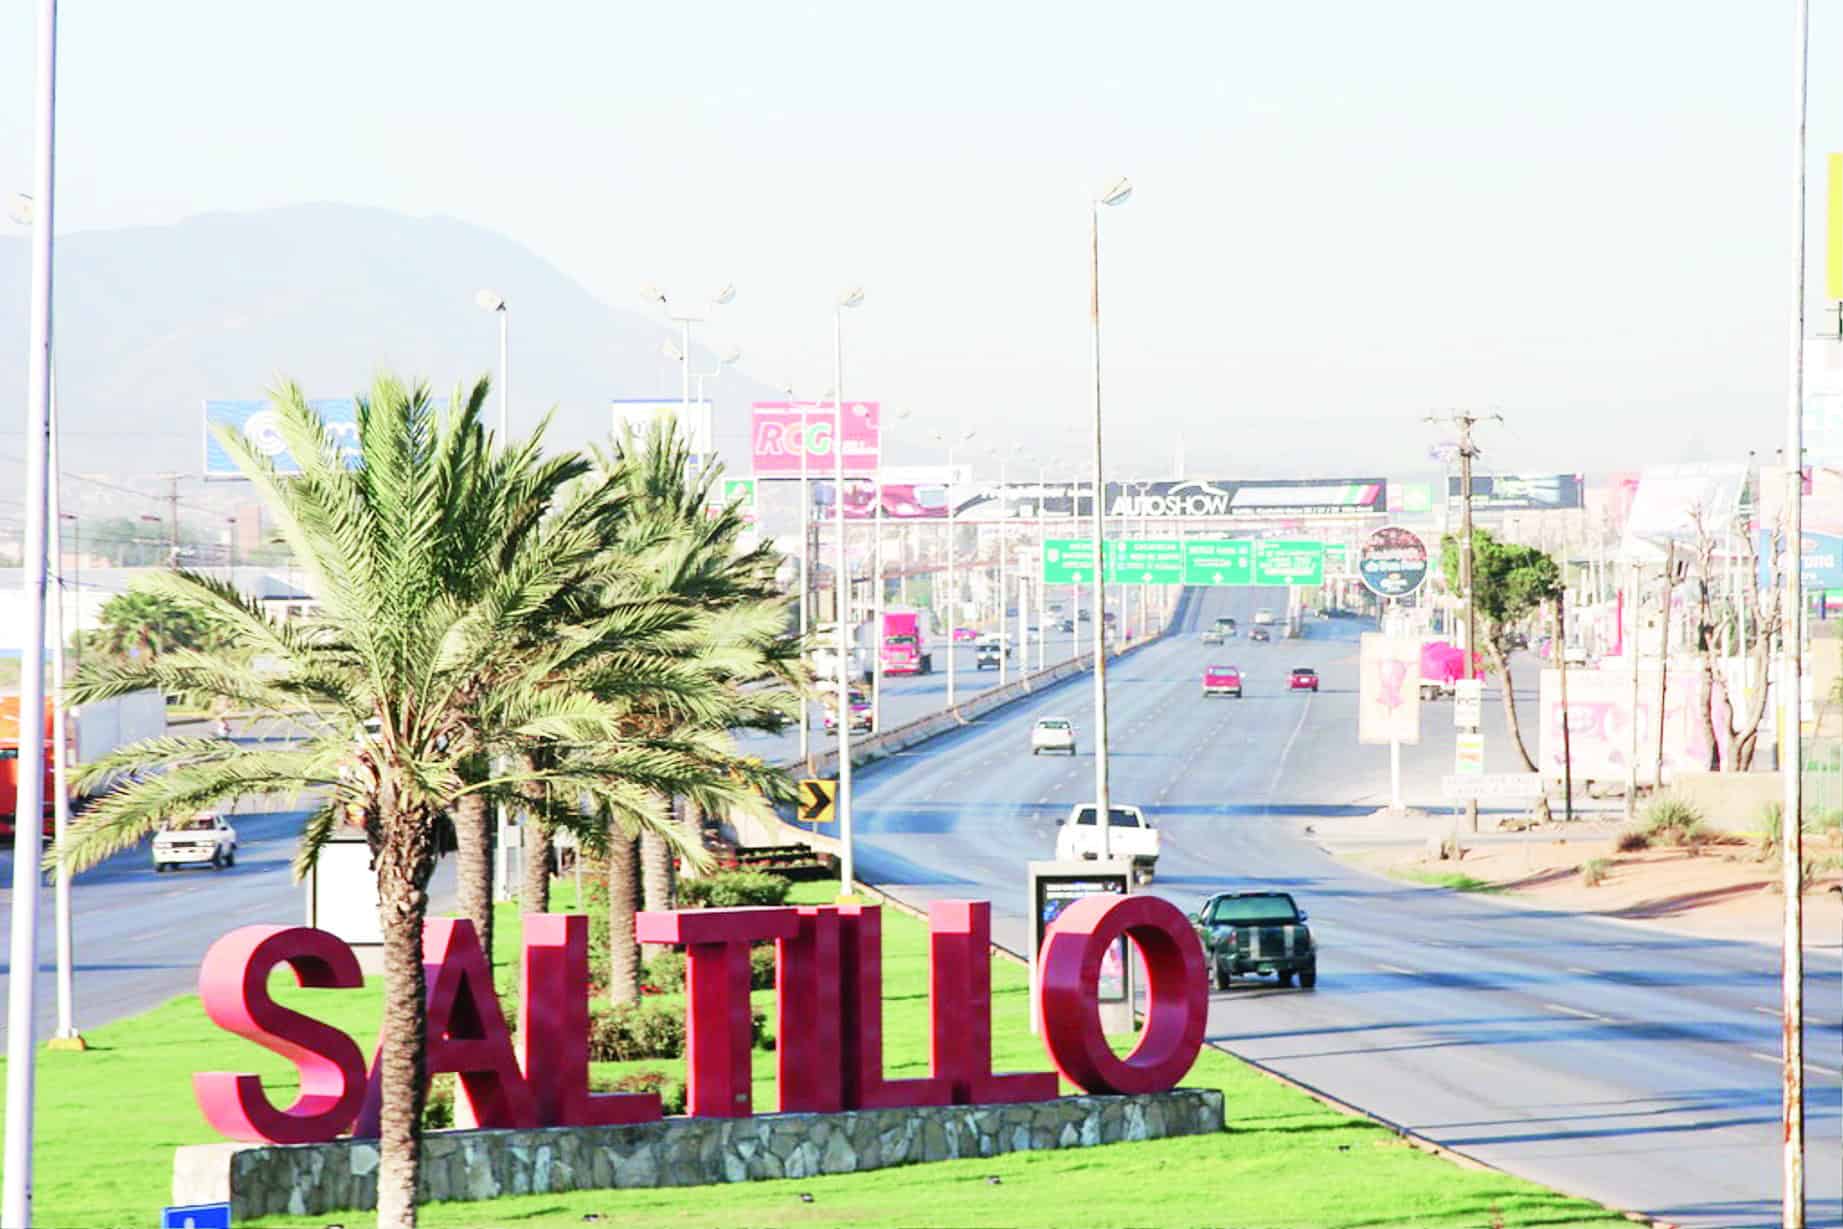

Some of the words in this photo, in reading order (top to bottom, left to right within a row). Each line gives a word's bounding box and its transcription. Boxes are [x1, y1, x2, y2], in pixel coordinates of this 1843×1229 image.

[755, 421, 832, 456] RCG
[1110, 494, 1229, 516] AUTOSHOW
[194, 893, 1208, 1144] SALTILLO
